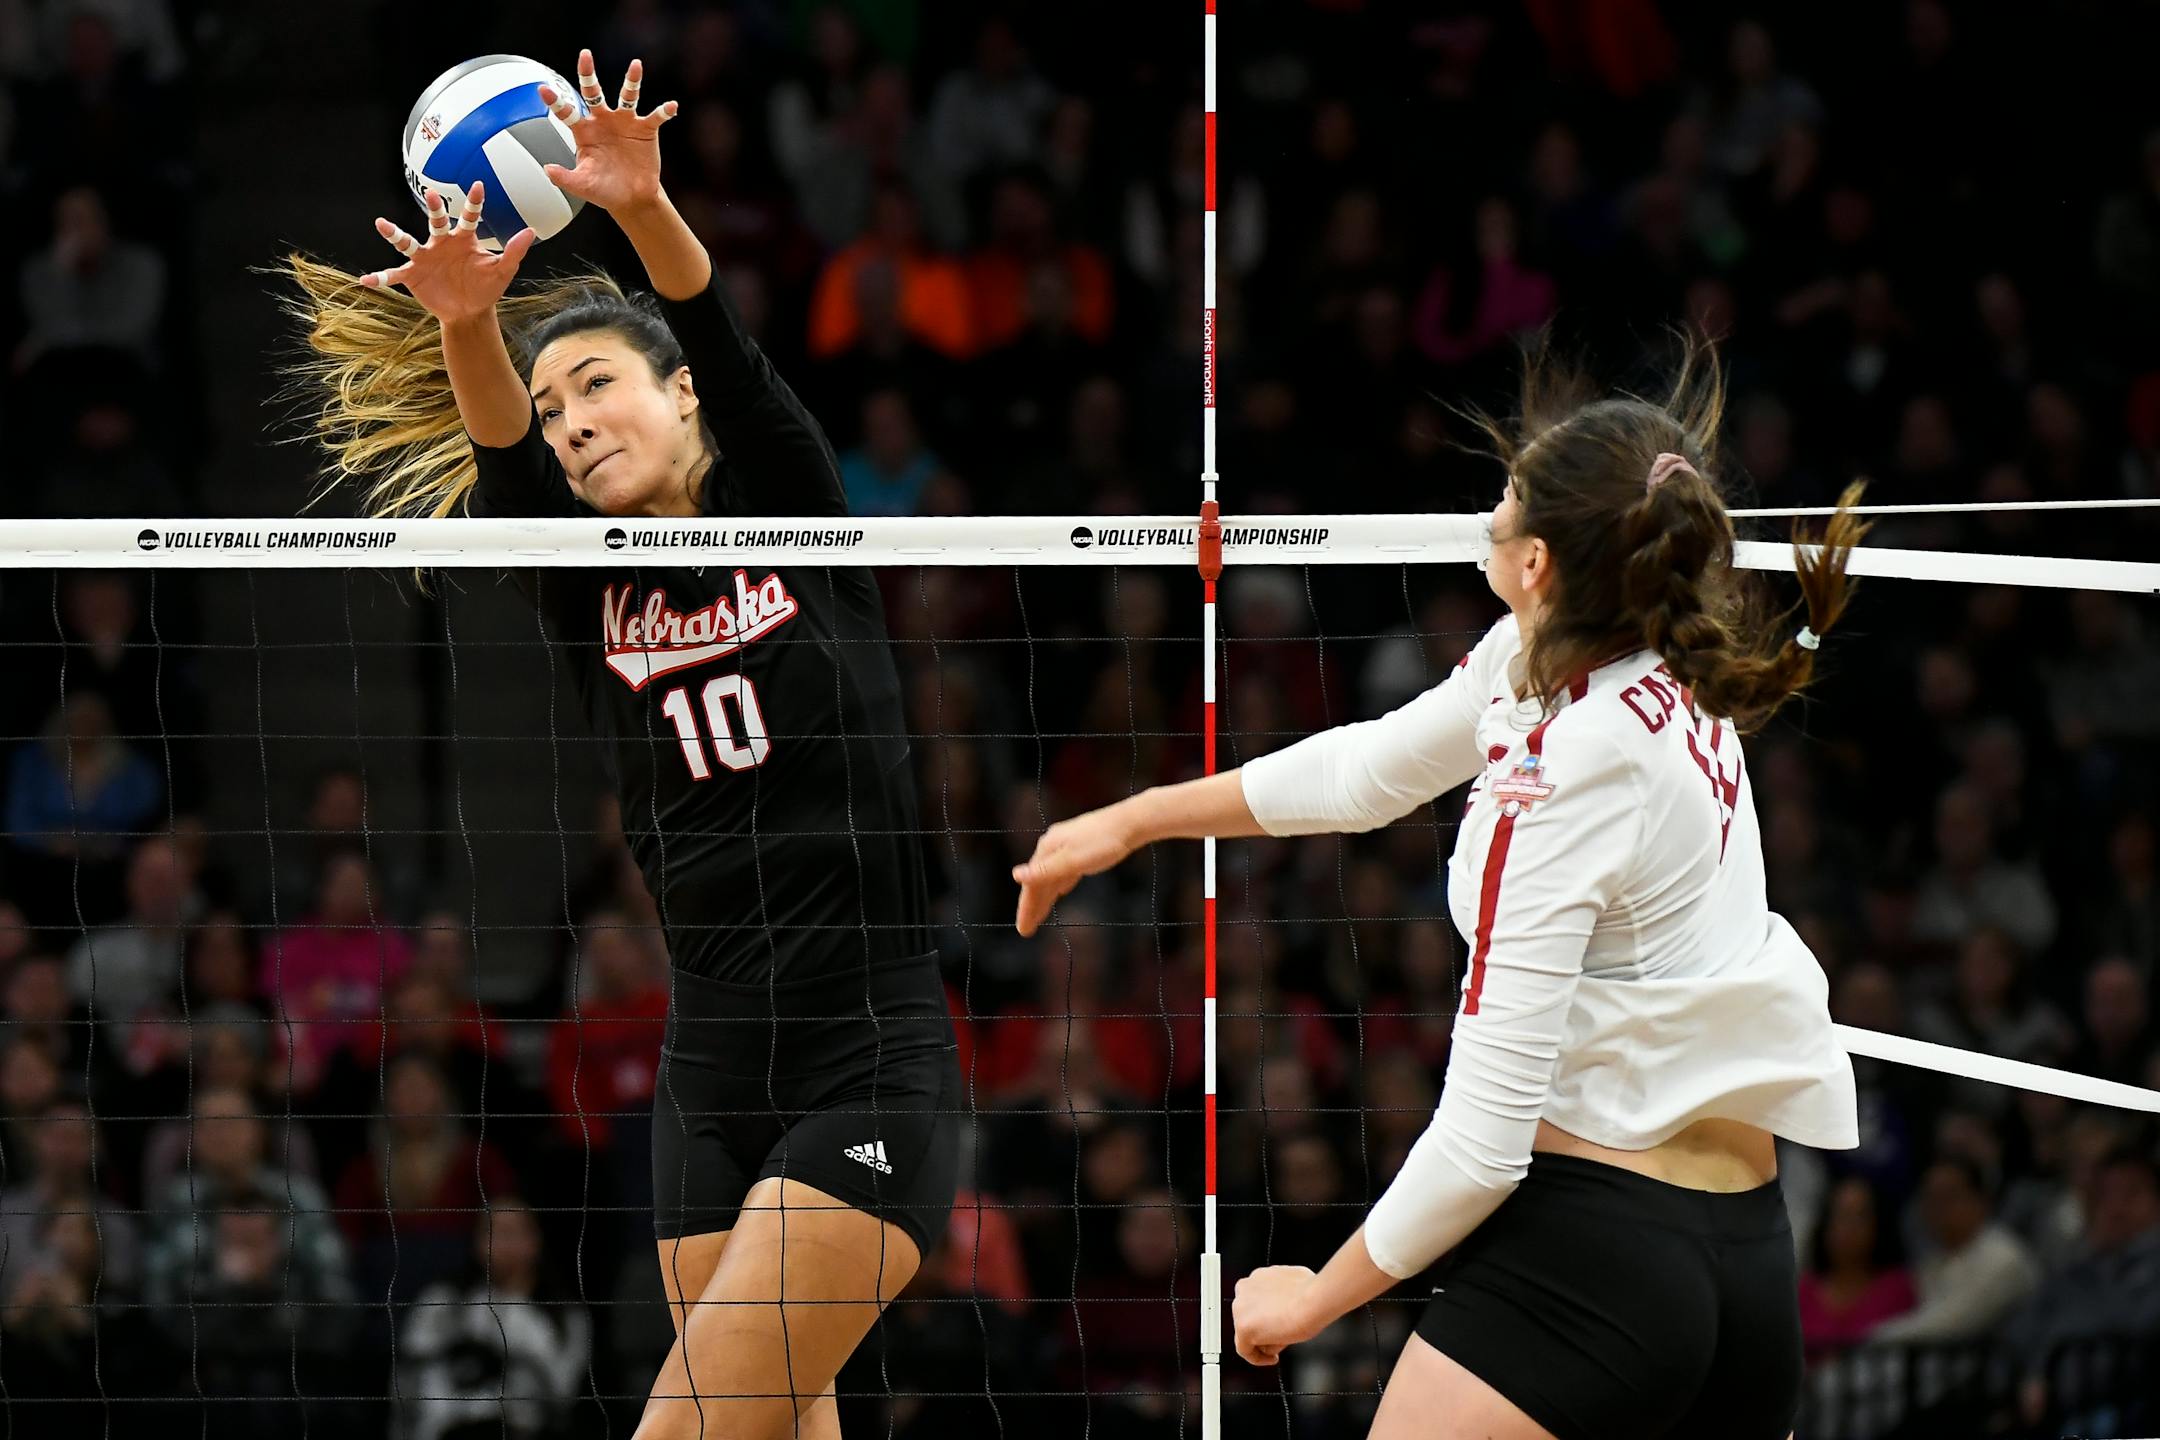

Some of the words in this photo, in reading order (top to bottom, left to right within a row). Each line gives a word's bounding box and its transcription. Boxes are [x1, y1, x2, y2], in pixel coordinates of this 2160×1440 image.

[165, 532, 261, 548] VOLLEYBALL
[267, 532, 396, 548] CHAMPIONSHIP
[632, 531, 728, 547] VOLLEYBALL
[734, 530, 863, 547] CHAMPIONSHIP
[1098, 529, 1194, 546] VOLLEYBALL
[1221, 528, 1329, 545] AMPIONSHIP
[603, 568, 798, 654] Nebraska
[661, 674, 772, 782] 10
